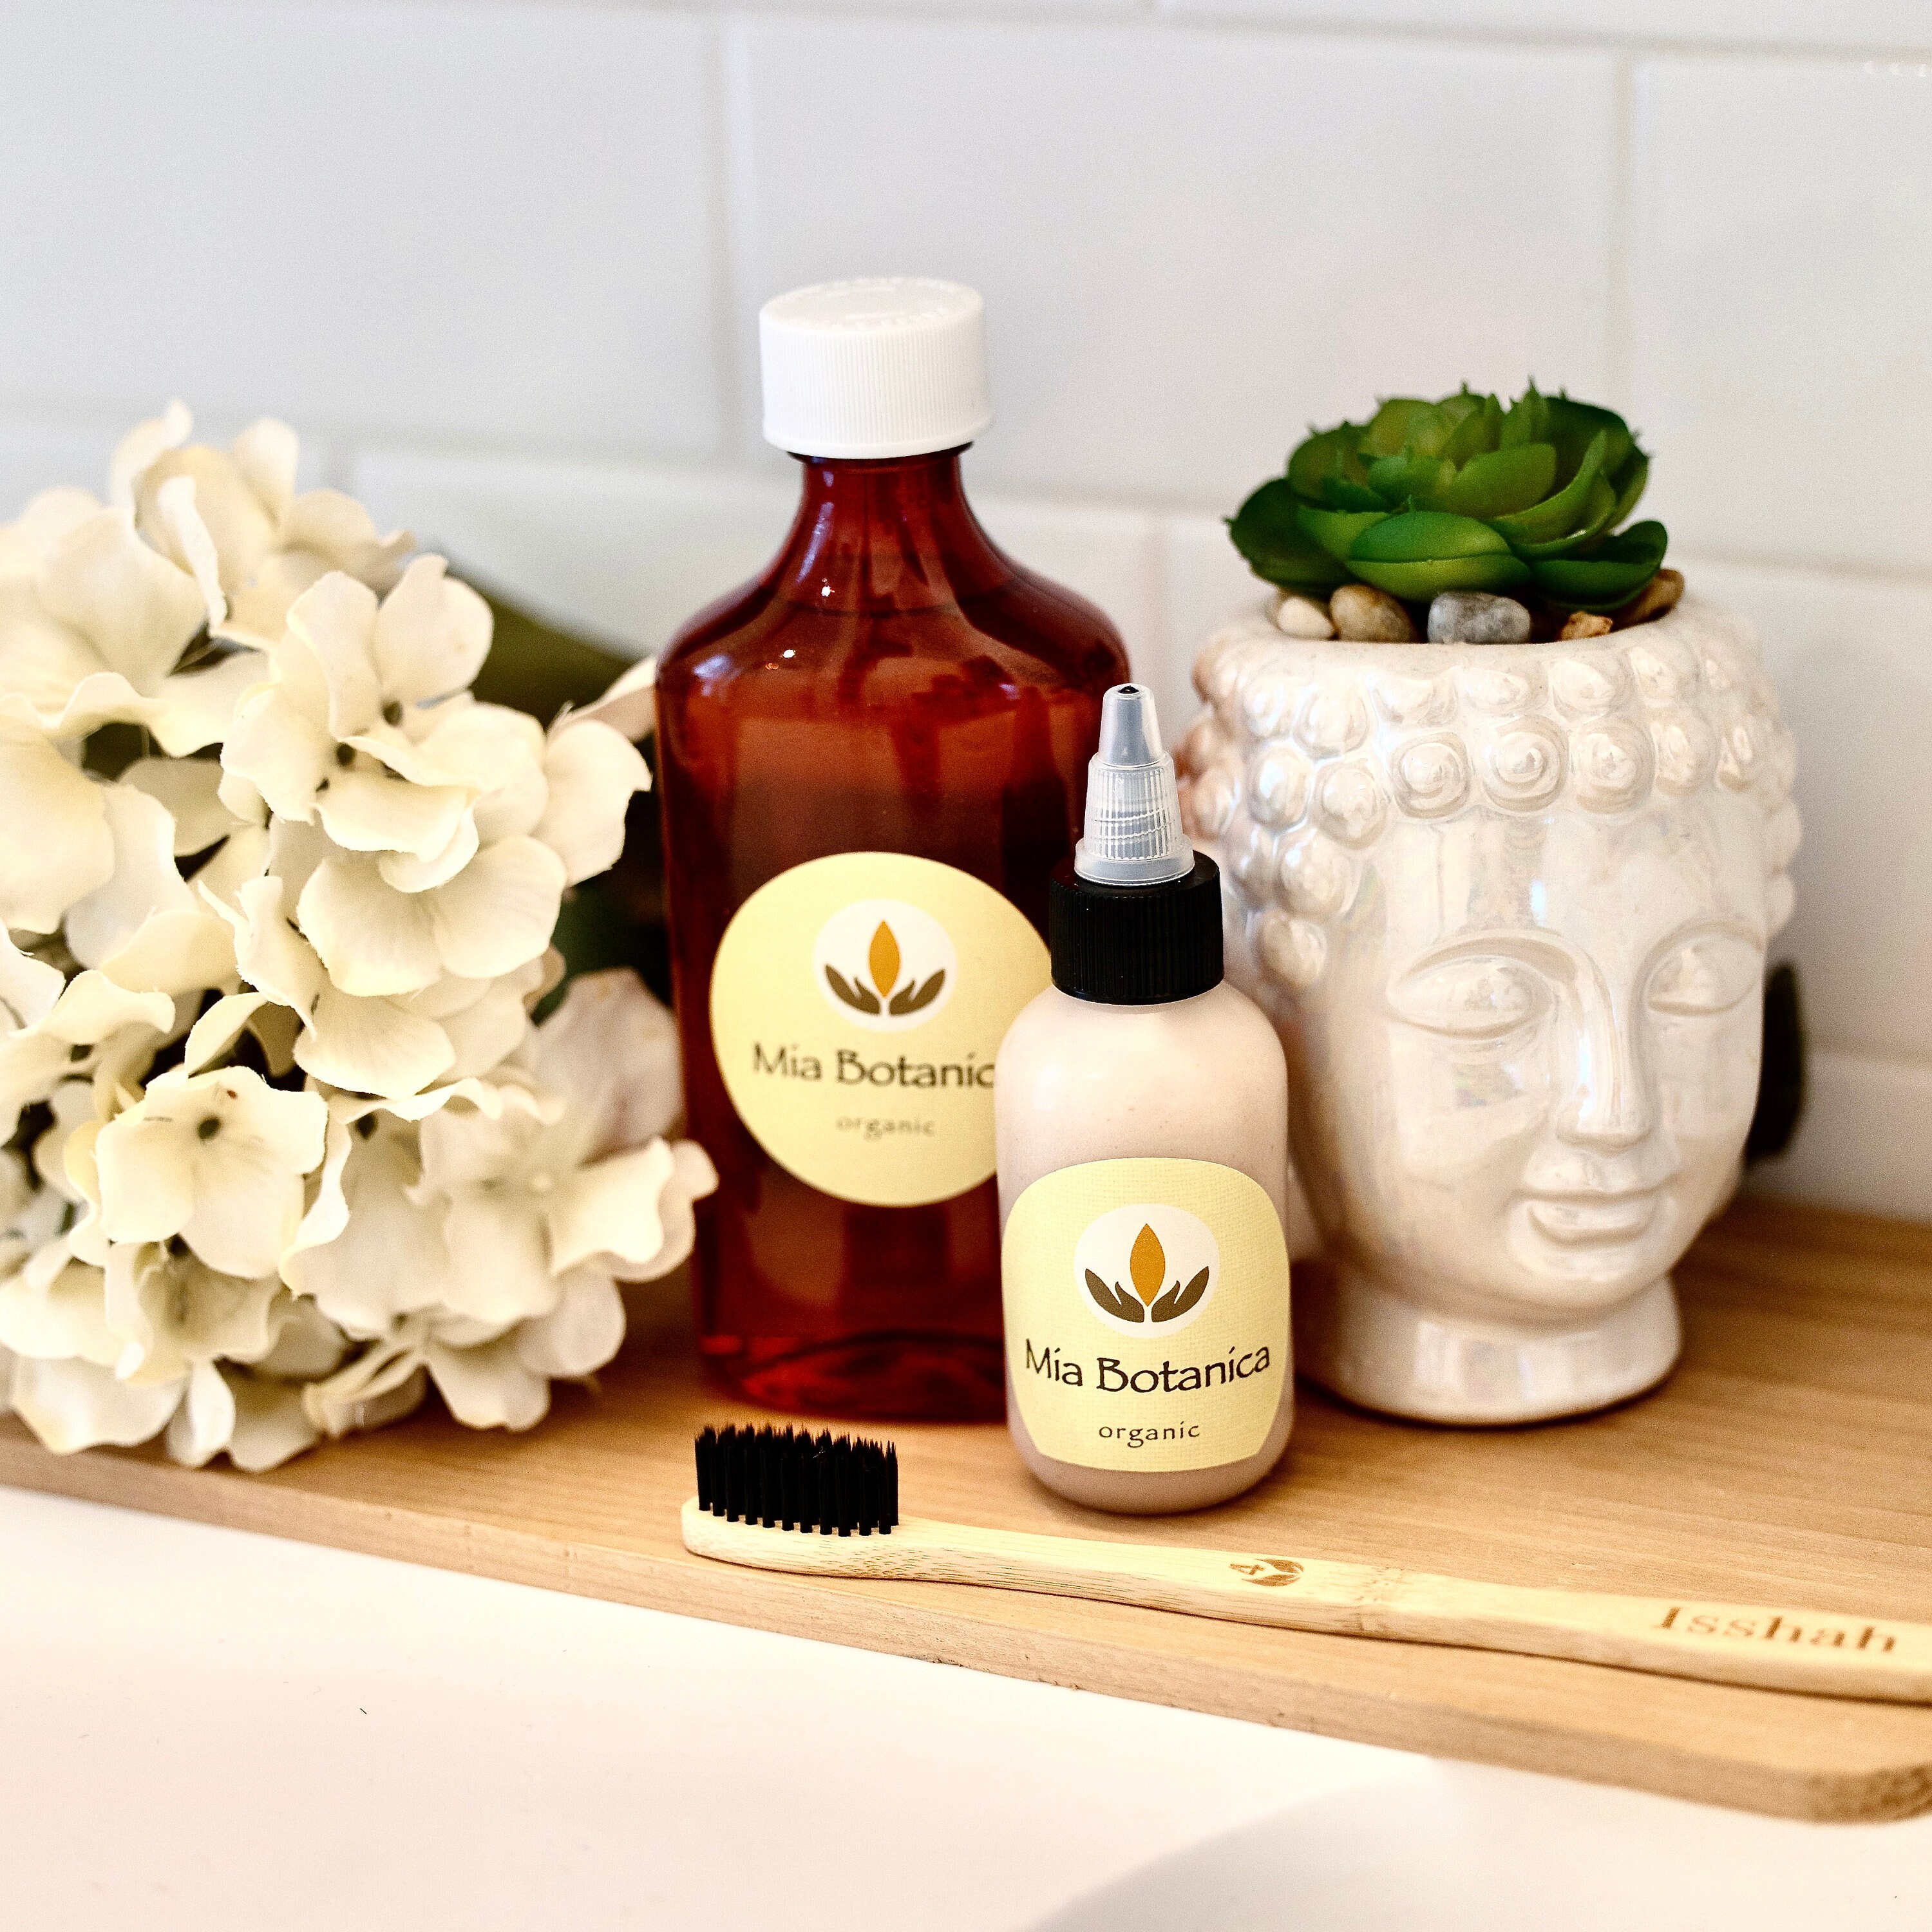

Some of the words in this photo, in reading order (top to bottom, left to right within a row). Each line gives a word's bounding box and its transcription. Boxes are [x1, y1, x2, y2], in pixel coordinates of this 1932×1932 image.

[752, 1041, 824, 1081] Mia
[836, 1115, 935, 1141] organic
[1025, 1338, 1084, 1387] Mia
[1096, 1345, 1271, 1394] Botanica
[1098, 1421, 1201, 1448] organic
[1653, 1606, 1898, 1654] Isshah
